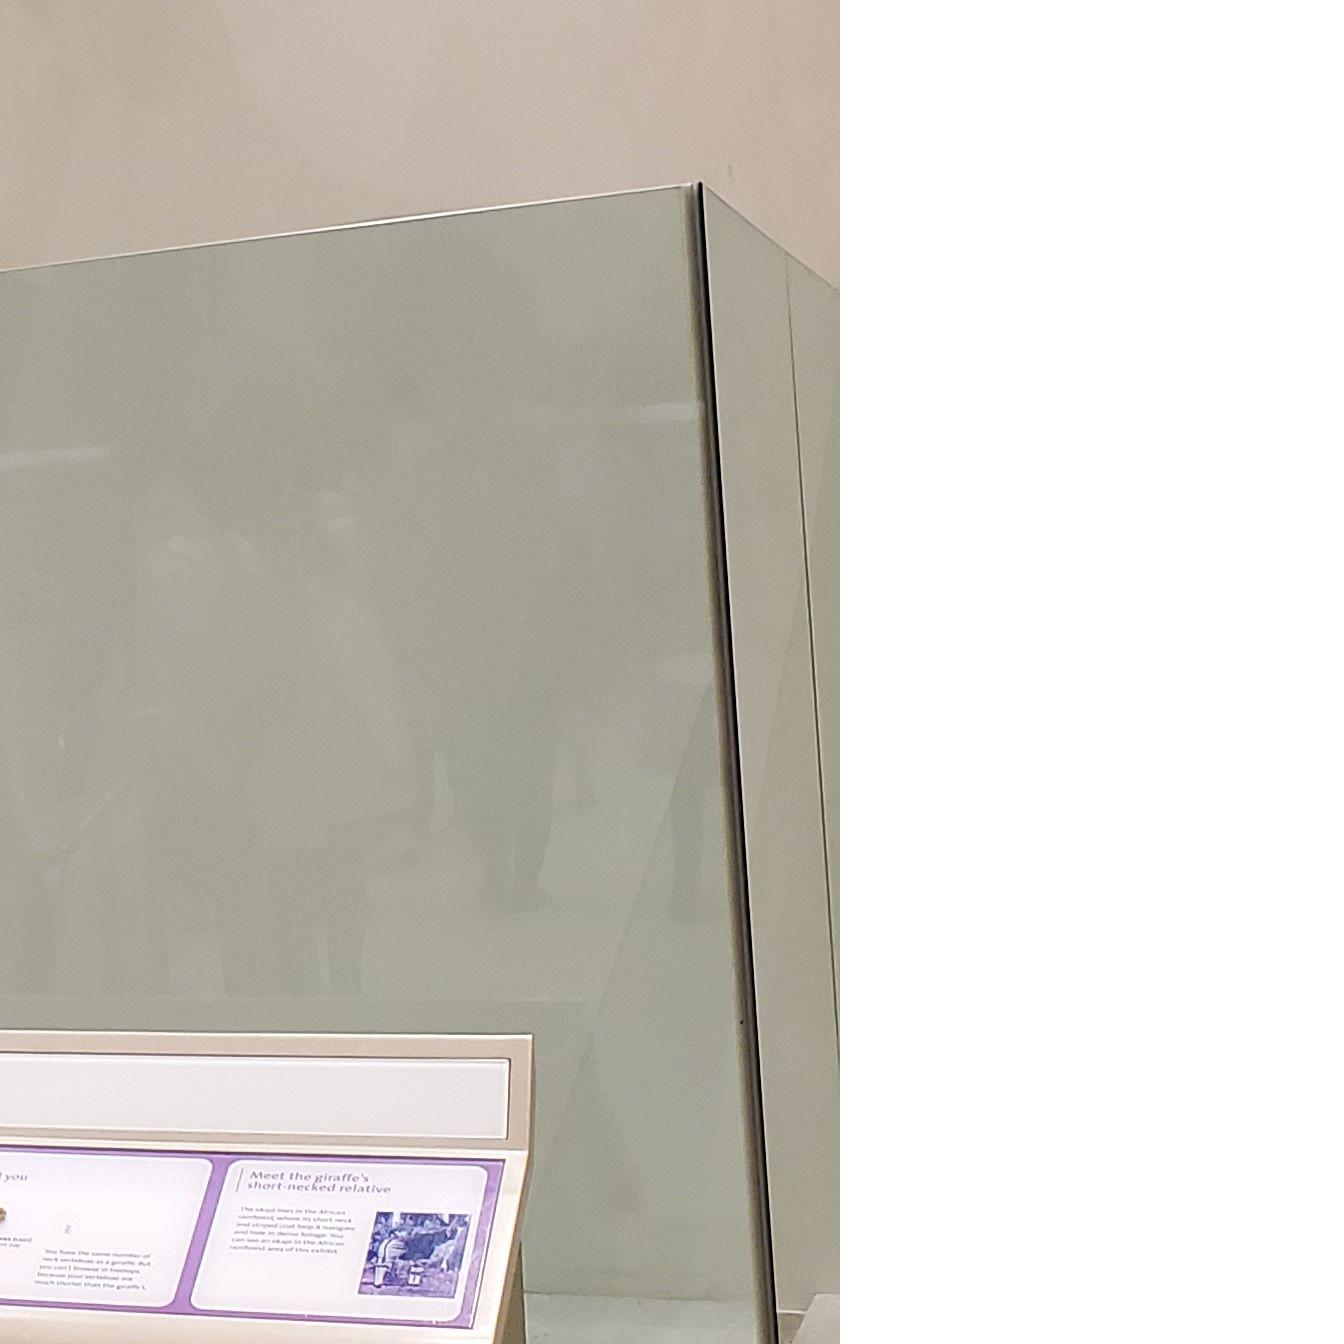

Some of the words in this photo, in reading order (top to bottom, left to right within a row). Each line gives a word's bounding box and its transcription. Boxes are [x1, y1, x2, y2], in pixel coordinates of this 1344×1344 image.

[4, 1174, 27, 1183] you
[249, 1171, 284, 1180] Meet
[290, 1172, 312, 1181] the
[315, 1173, 369, 1183] giraffe's
[247, 1181, 336, 1192] short-necked
[340, 1184, 391, 1194] relative
